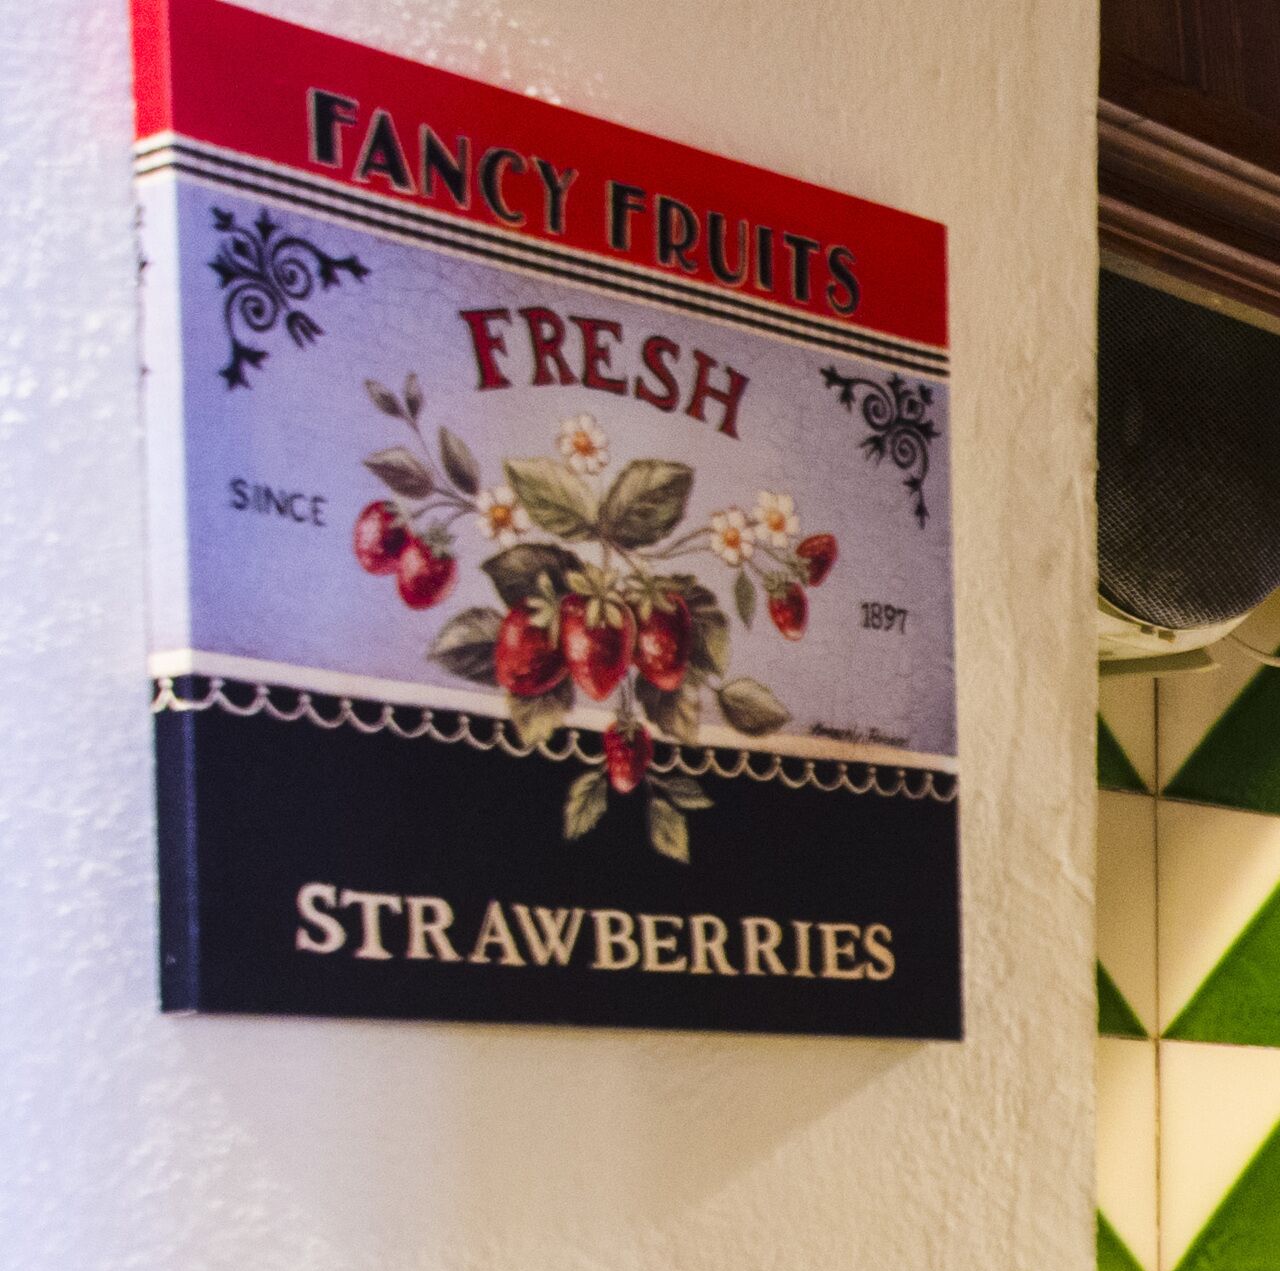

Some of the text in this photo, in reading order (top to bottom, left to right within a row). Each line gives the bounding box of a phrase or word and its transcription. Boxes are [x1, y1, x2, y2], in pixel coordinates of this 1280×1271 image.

[307, 87, 862, 317] FANCY FRUITS
[459, 306, 750, 439] FRESH
[229, 478, 328, 527] SINCE
[861, 602, 909, 635] 1897
[295, 881, 896, 982] STRAWBERRIES
